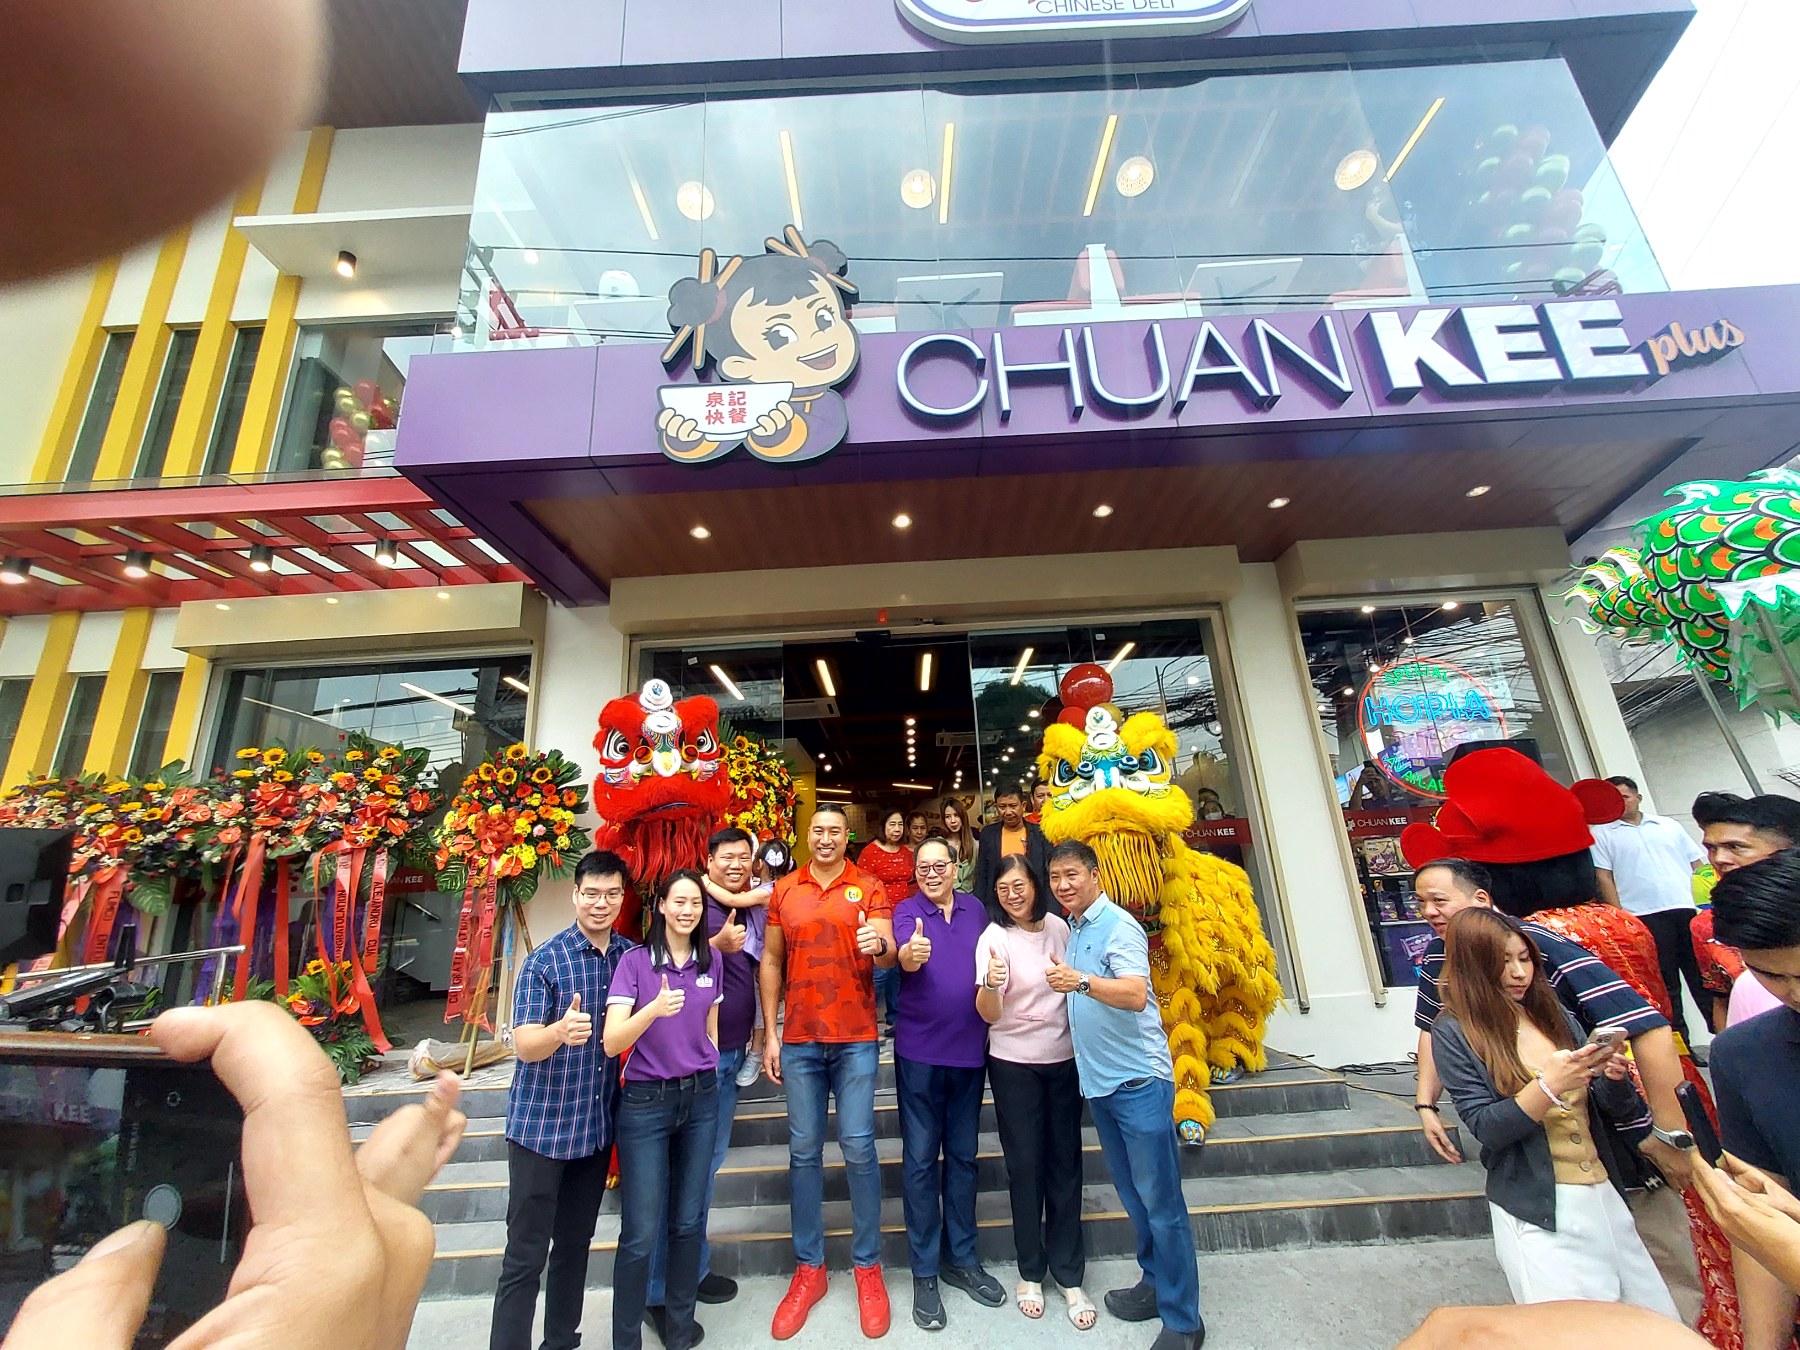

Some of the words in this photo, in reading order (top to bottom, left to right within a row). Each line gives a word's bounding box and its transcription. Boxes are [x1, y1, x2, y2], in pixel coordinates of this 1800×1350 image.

[1036, 0, 1125, 14] CHINESE
[1133, 0, 1175, 10] DELI
[897, 315, 1354, 417] CHUAN
[1366, 300, 1650, 390] KEE
[1646, 319, 1745, 377] plus
[705, 390, 747, 408] 泉記
[705, 407, 747, 425] 快餐
[1384, 663, 1450, 687] SPECIAL
[1364, 689, 1492, 726] HOPIA
[1357, 817, 1388, 828] CHUAN
[1388, 816, 1408, 826] KEE
[1185, 828, 1217, 839] CHUAN
[1216, 827, 1236, 837] KEE
[404, 875, 424, 884] KEE
